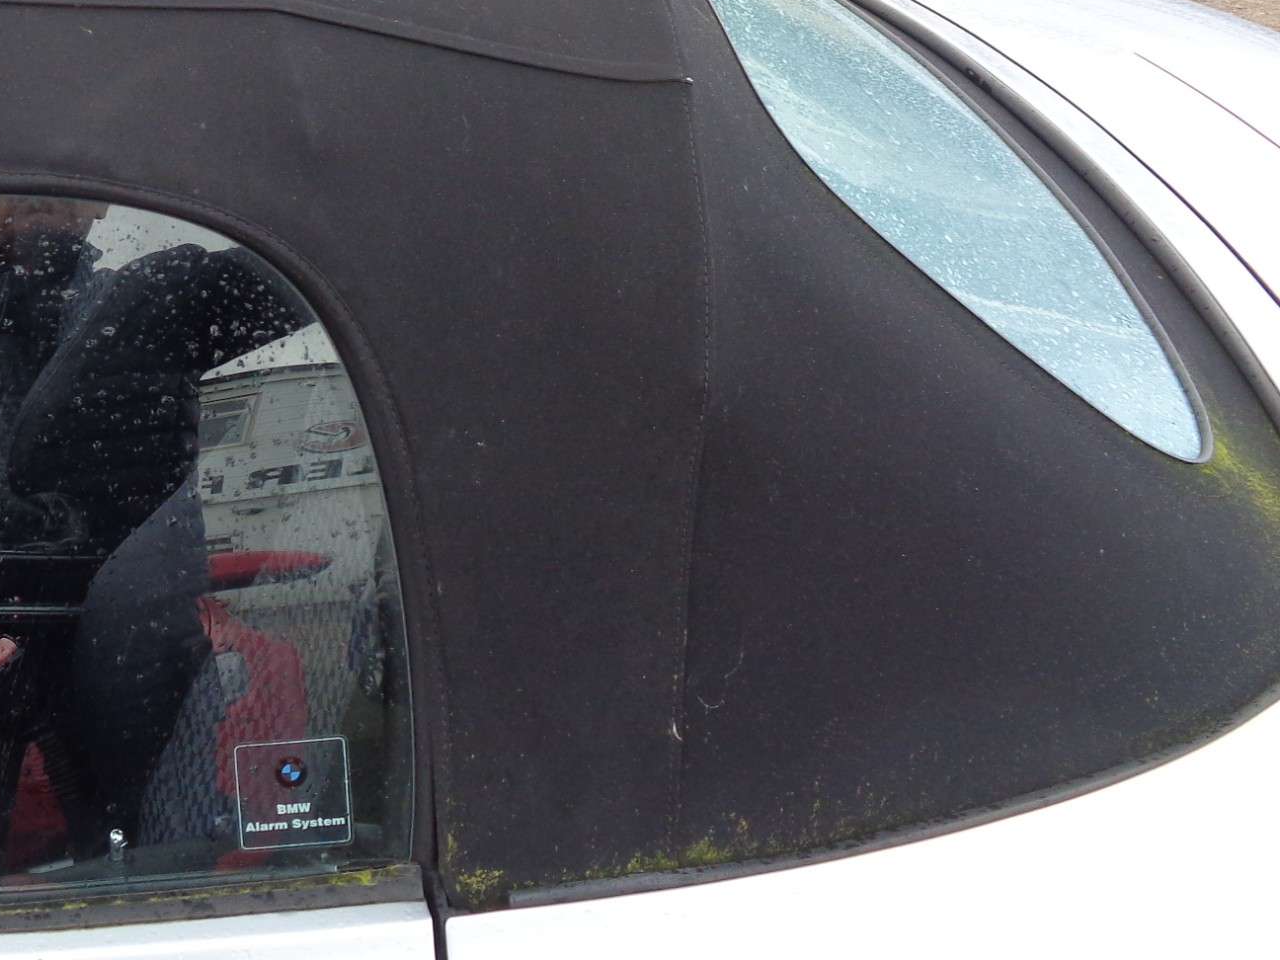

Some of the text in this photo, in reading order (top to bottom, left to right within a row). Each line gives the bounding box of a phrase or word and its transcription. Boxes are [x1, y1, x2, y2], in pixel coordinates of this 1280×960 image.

[276, 802, 311, 815] BMW
[246, 816, 345, 833] Alarm System
